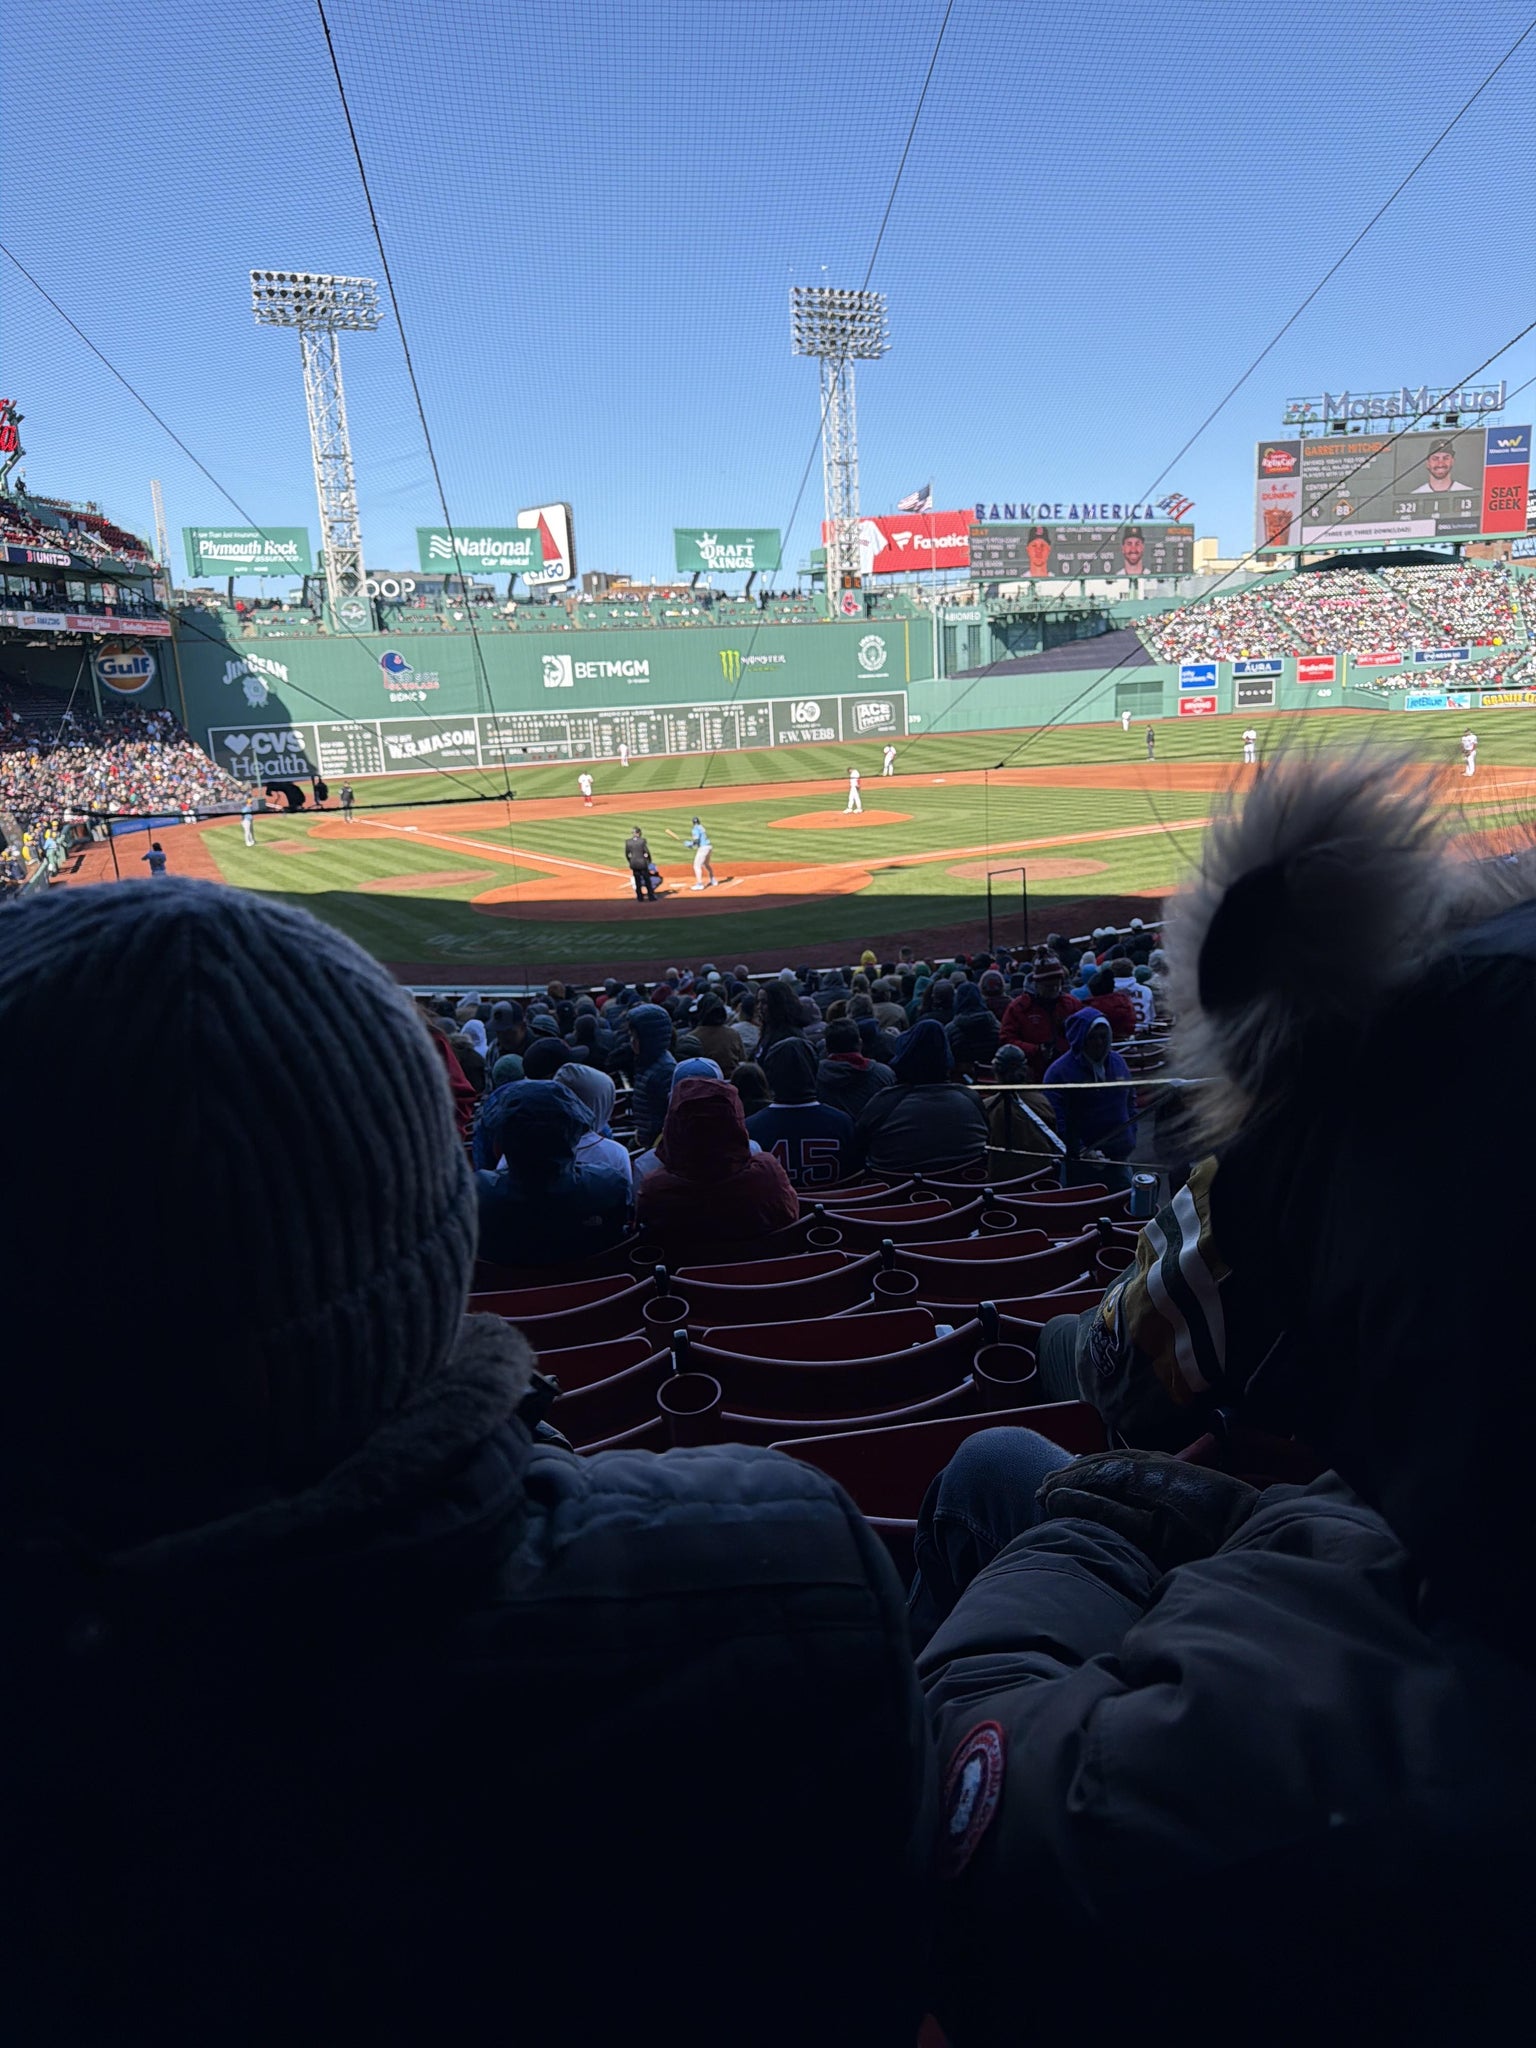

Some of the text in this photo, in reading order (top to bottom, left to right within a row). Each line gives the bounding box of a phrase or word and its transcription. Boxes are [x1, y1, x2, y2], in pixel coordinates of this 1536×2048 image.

[1322, 380, 1507, 420] MassMutual
[1304, 444, 1346, 457] GARRETT
[1491, 486, 1522, 498] SEAT
[976, 503, 1155, 520] BANK OF AMERICA
[1311, 499, 1472, 517] K BB .321 1 13
[1488, 498, 1522, 511] GEEK
[199, 539, 298, 557] Plymouth Rock
[455, 536, 532, 557] National
[913, 532, 970, 550] Fanatics
[700, 543, 755, 559] DRAFT
[36, 552, 71, 567] UNITED
[481, 556, 498, 566] Car
[708, 556, 755, 569] KINGS
[100, 656, 150, 677] Gulf
[741, 655, 786, 665] MONSTER
[222, 659, 248, 685] JIM
[574, 660, 650, 679] BETMGM
[1317, 688, 1332, 697] 420
[1482, 692, 1519, 706] GRANITE
[859, 703, 891, 717] ACE
[1410, 696, 1443, 708] jetBlue
[790, 701, 821, 724] 160
[861, 714, 892, 728] TICKET
[251, 730, 306, 755] CVS
[779, 727, 835, 744] F.W. WEBB
[230, 753, 309, 778] Health
